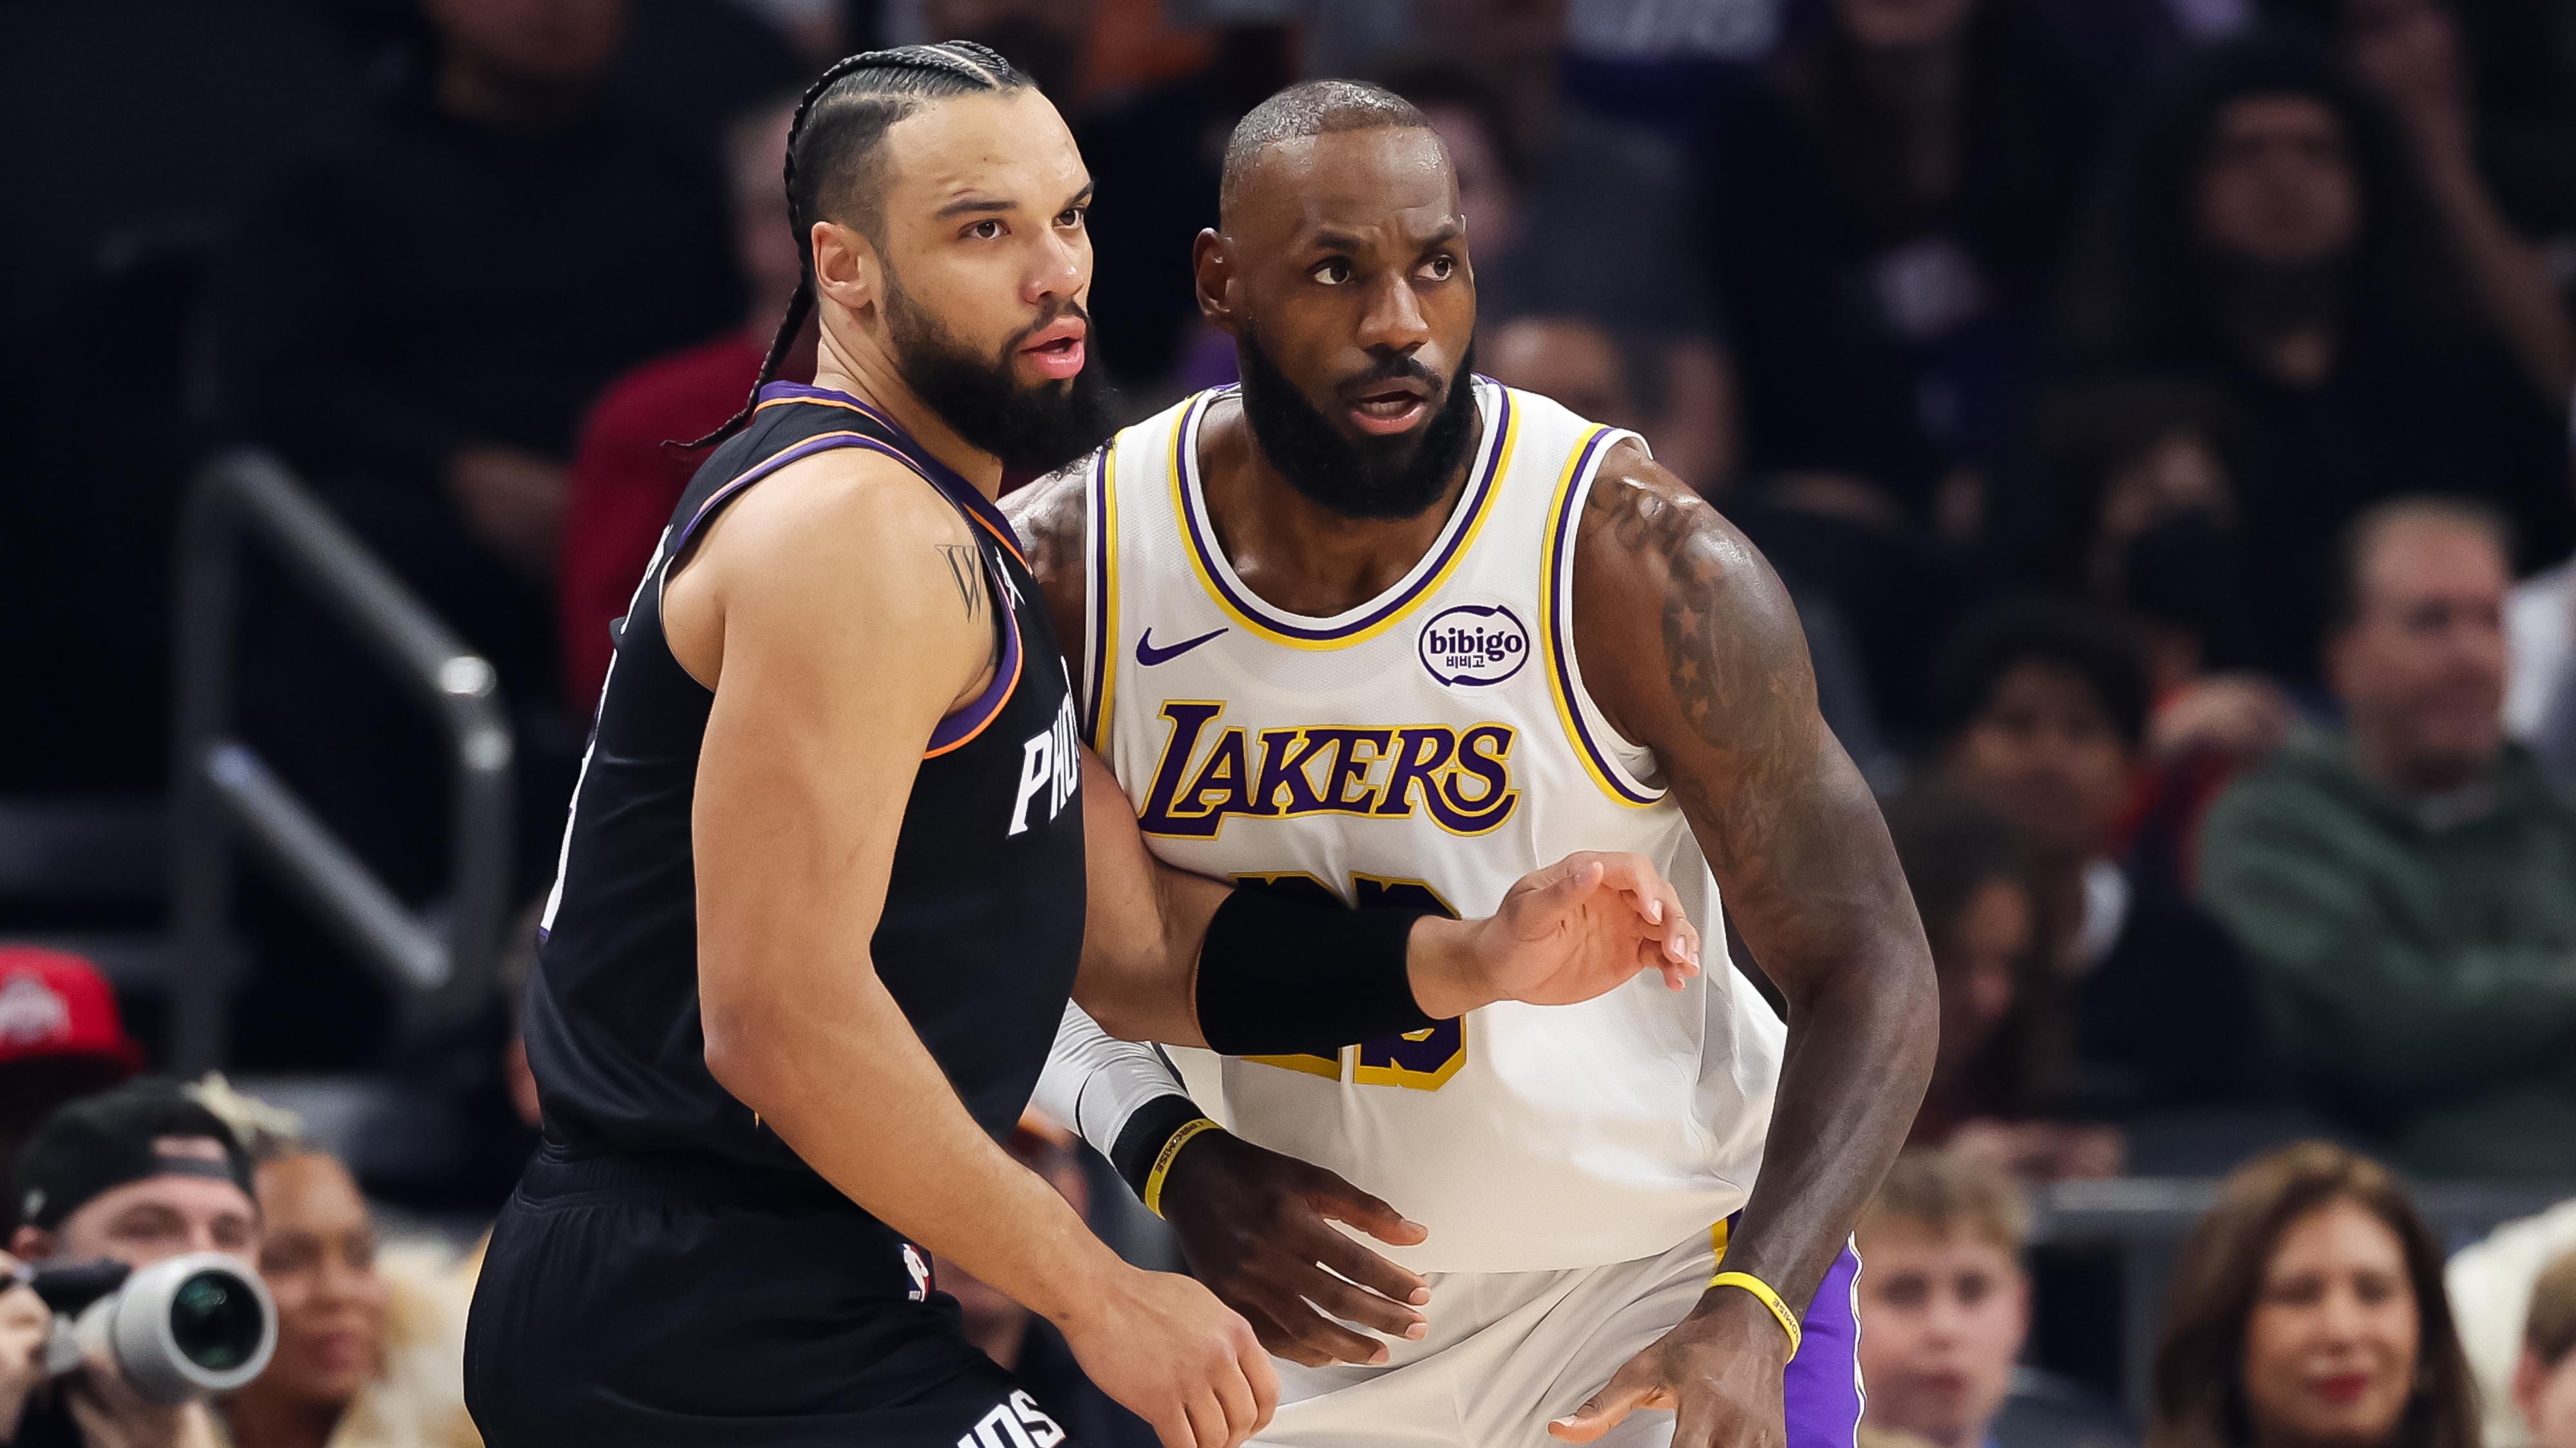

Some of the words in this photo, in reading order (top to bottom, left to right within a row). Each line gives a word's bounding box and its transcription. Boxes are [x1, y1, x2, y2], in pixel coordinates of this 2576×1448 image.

[1430, 627, 1522, 662] bibigo
[1446, 655, 1485, 669] 비비고
[1007, 654, 1080, 839] PHO
[1137, 700, 1521, 839] LAKERS
